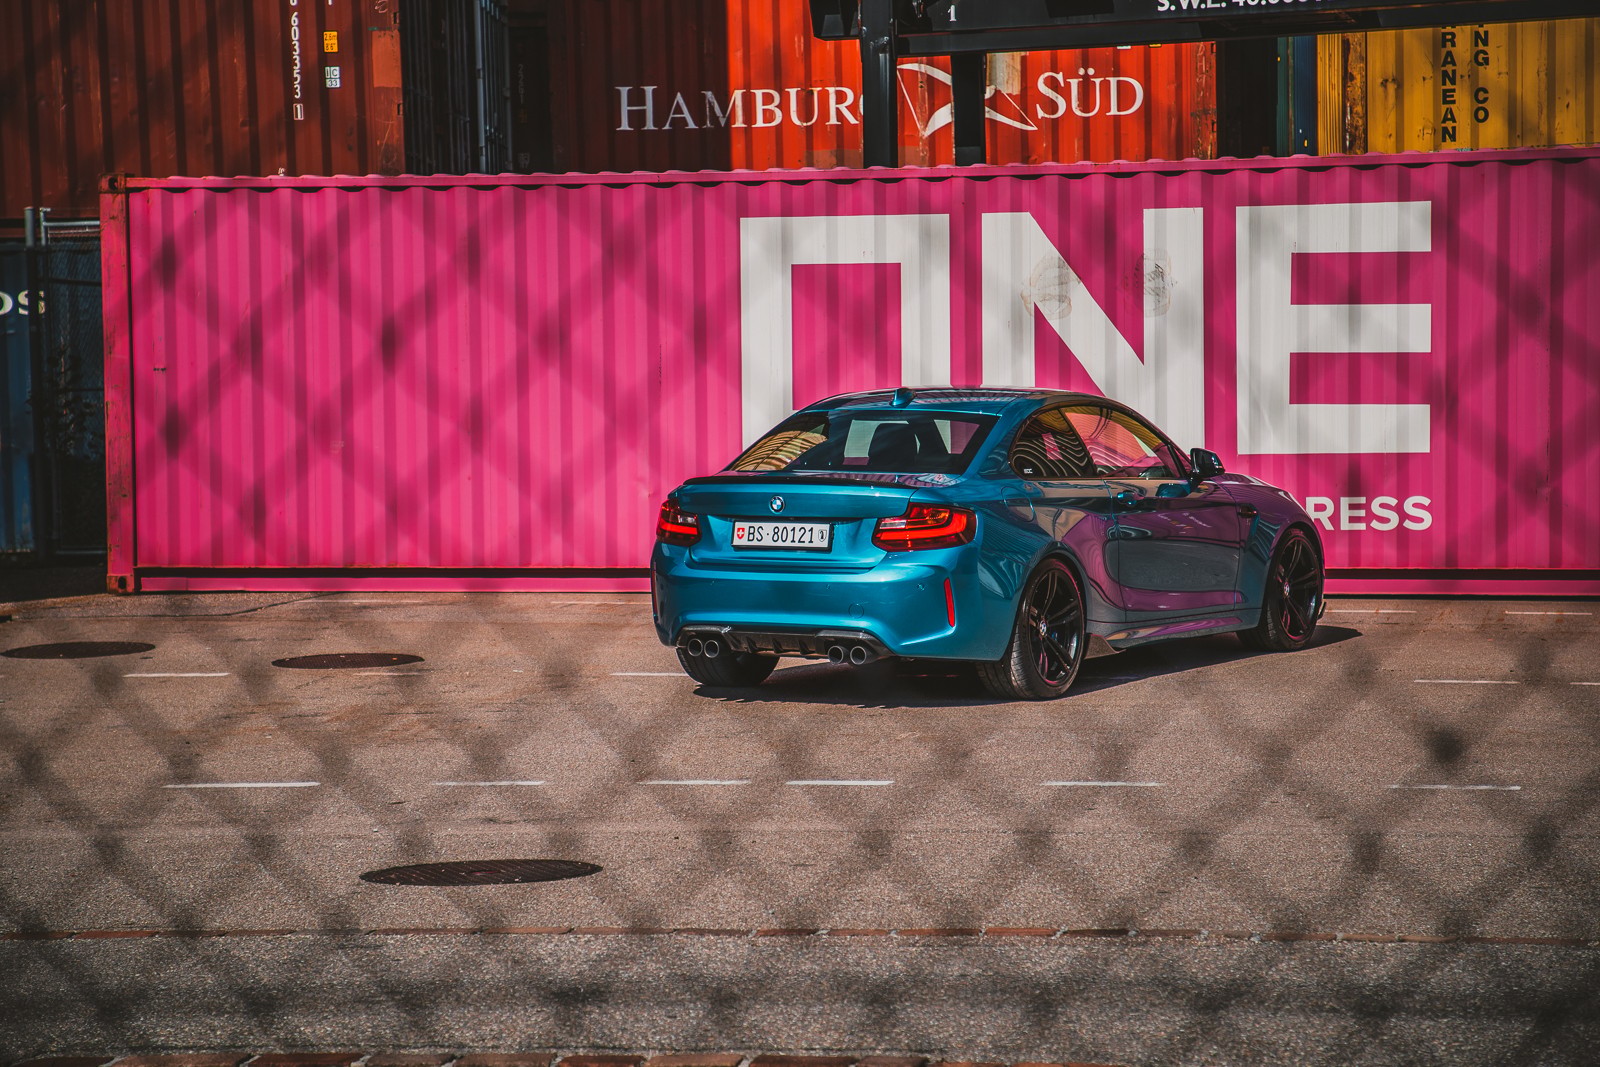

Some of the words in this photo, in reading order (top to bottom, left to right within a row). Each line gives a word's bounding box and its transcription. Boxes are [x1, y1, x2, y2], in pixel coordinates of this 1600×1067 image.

[947, 4, 957, 22] 1
[291, 12, 301, 99] 603353
[1474, 25, 1489, 66] NG
[614, 85, 864, 131] HAMBUR
[1036, 67, 1144, 119] SÜD
[1441, 27, 1457, 142] RANEAN
[1474, 87, 1489, 123] CO
[740, 201, 1431, 454] ONE
